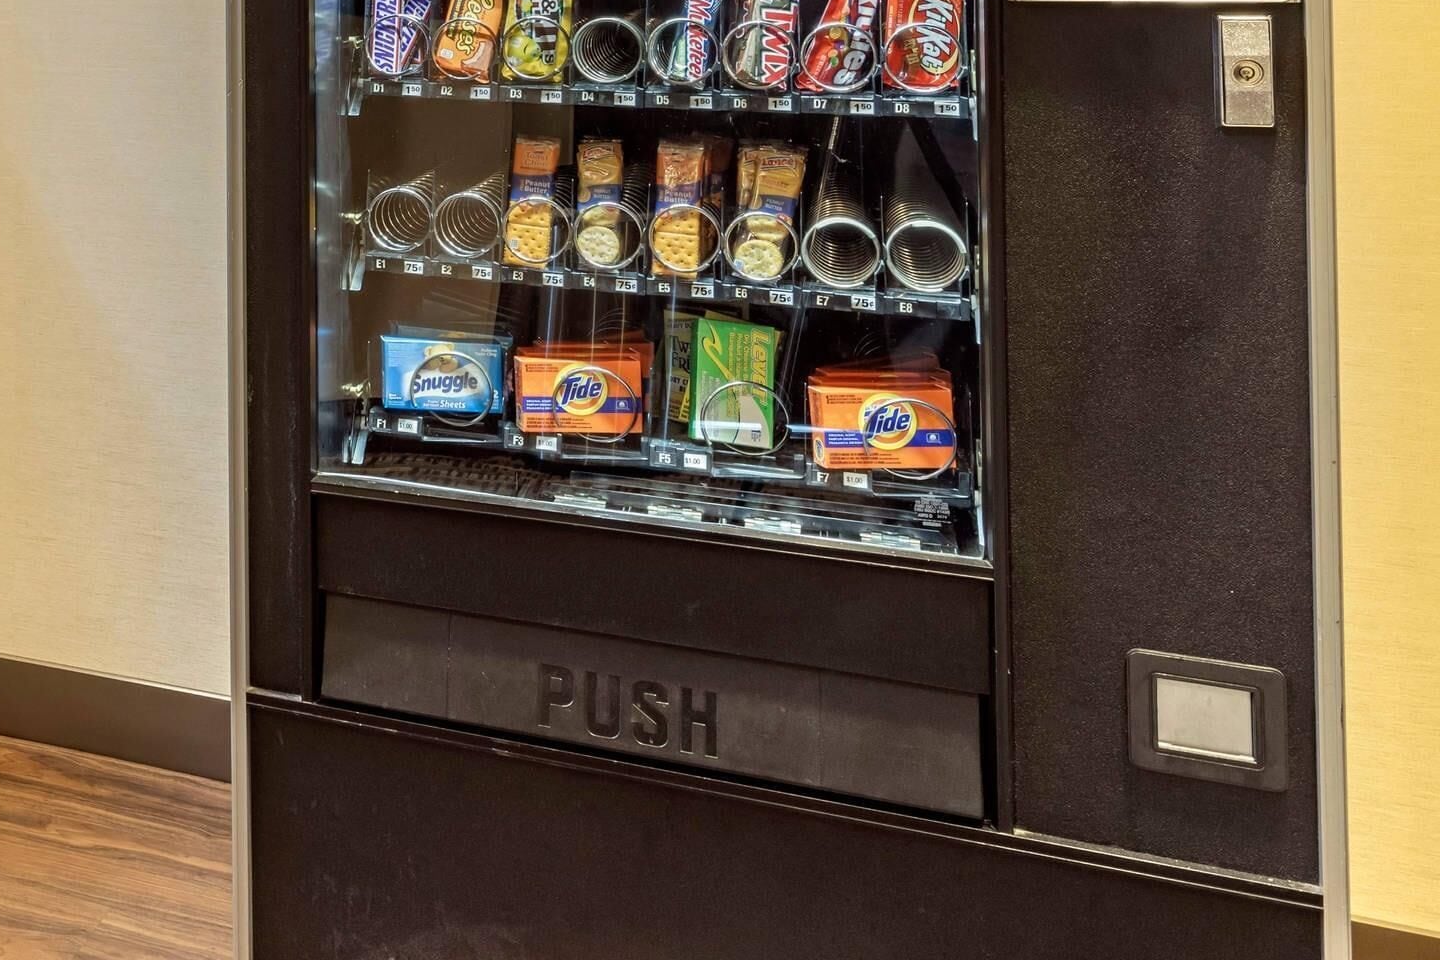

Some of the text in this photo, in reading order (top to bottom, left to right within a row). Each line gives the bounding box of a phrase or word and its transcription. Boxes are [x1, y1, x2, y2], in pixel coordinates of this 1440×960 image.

[761, 2, 799, 91] TWIX
[373, 84, 384, 93] D1
[441, 85, 453, 95] D2
[510, 89, 522, 99] D3
[582, 92, 594, 102] D4
[656, 96, 669, 105] D5
[733, 98, 747, 108] D6
[813, 99, 827, 109] D7
[895, 104, 909, 113] D8
[525, 179, 550, 188] Peanut
[524, 186, 548, 194] Butter
[376, 259, 386, 269] E1
[658, 284, 671, 293] E5
[735, 288, 747, 298] E6
[816, 295, 829, 306] E7
[900, 303, 913, 313] E8
[413, 372, 478, 394] Snuggle
[561, 376, 603, 406] Tide
[440, 400, 466, 409] Sheets
[376, 418, 386, 428] F1
[865, 406, 911, 439] Tide
[659, 453, 701, 466] F5 $1.00
[817, 473, 829, 482] F7
[539, 662, 719, 759] PUSH
